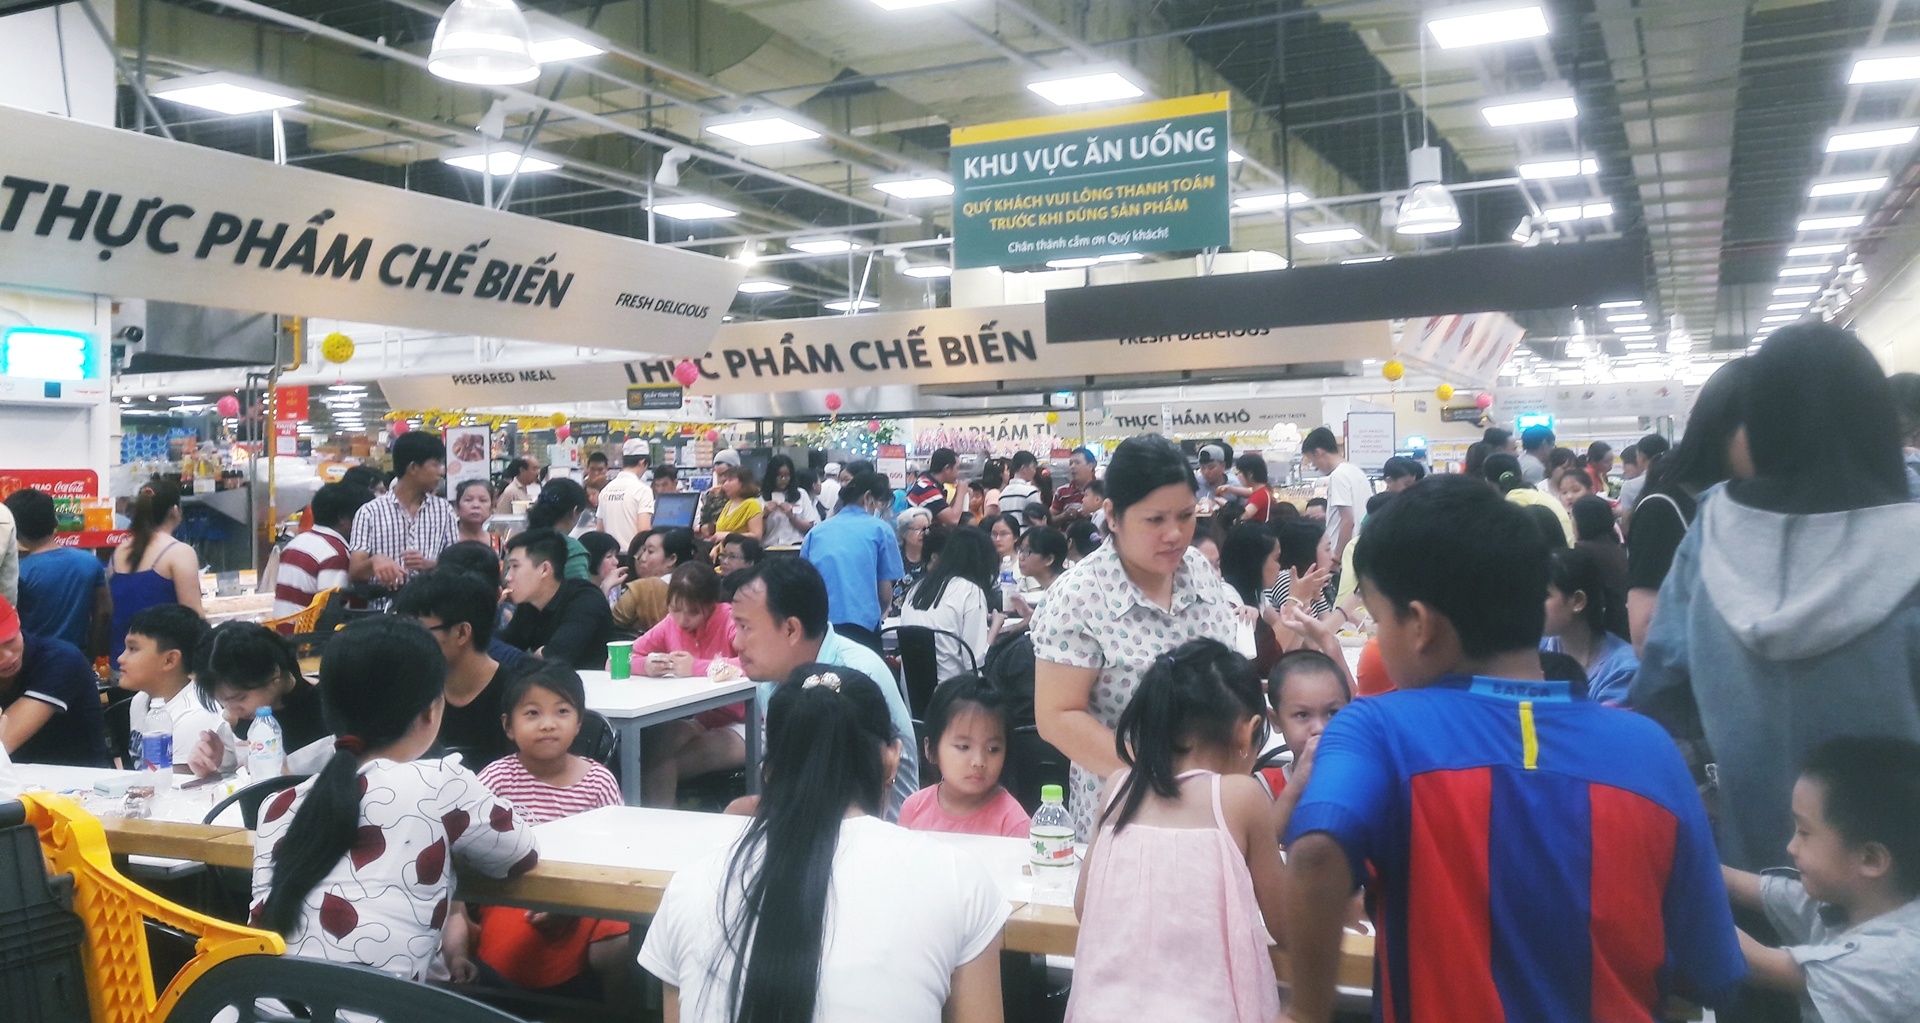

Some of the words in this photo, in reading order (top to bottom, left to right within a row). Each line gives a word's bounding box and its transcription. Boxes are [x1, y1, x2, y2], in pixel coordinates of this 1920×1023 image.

[963, 152, 1018, 180] KHU
[1023, 143, 1080, 176] VỰC
[1083, 136, 1124, 166] ĂN
[1129, 123, 1217, 160] UỐNG
[962, 199, 992, 218] QUÝ
[994, 194, 1044, 213] KHÁCH
[1045, 193, 1071, 207] VUI
[1071, 186, 1114, 204] LÒNG
[1115, 182, 1170, 199] THANH
[1171, 174, 1216, 193] TOÁN
[988, 211, 1037, 231] TRƯỚC
[1038, 211, 1065, 227] KHI
[1110, 202, 1142, 219] SẢN
[1142, 197, 1189, 216] PHẨM
[0, 175, 196, 262] THỰC
[195, 208, 373, 281] PHẨM
[378, 238, 491, 295] CHẾ
[473, 252, 575, 309] BIẾN
[1006, 240, 1036, 254] Chân
[1106, 230, 1131, 246] Quý
[1132, 226, 1170, 241] khách!
[615, 292, 654, 311] FRESH
[652, 299, 711, 319] DELICIOUS
[722, 332, 845, 378] PHẨM
[850, 325, 933, 371] CHẾ
[938, 319, 1038, 366] BIẾN
[452, 372, 516, 386] PREPARED
[518, 370, 557, 382] MEAL
[1114, 413, 1159, 430] THỰC
[1160, 408, 1211, 427] HẨM
[1213, 408, 1251, 425] KHÔ
